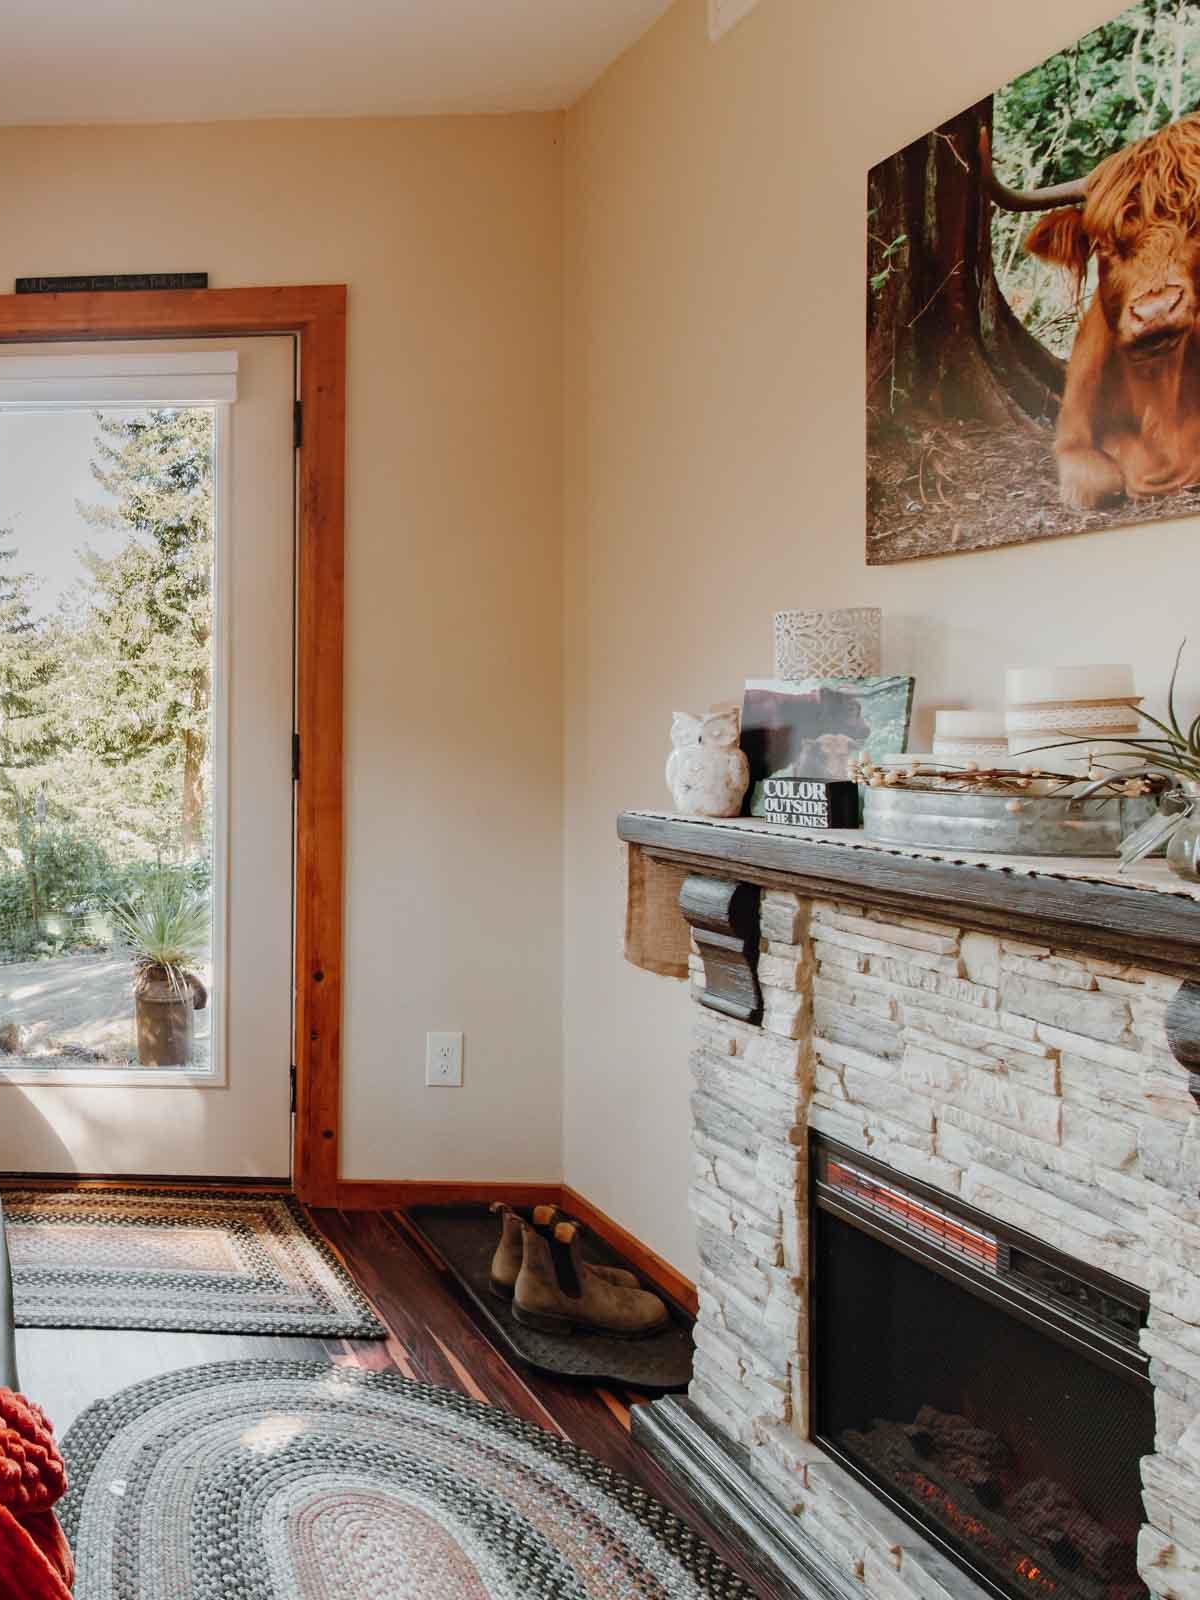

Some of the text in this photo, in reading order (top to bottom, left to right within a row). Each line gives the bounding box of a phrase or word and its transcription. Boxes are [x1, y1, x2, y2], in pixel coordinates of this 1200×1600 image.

[764, 780, 828, 800] COLOR
[765, 798, 828, 816] OUTSIDE
[767, 813, 828, 828] THE LINES
